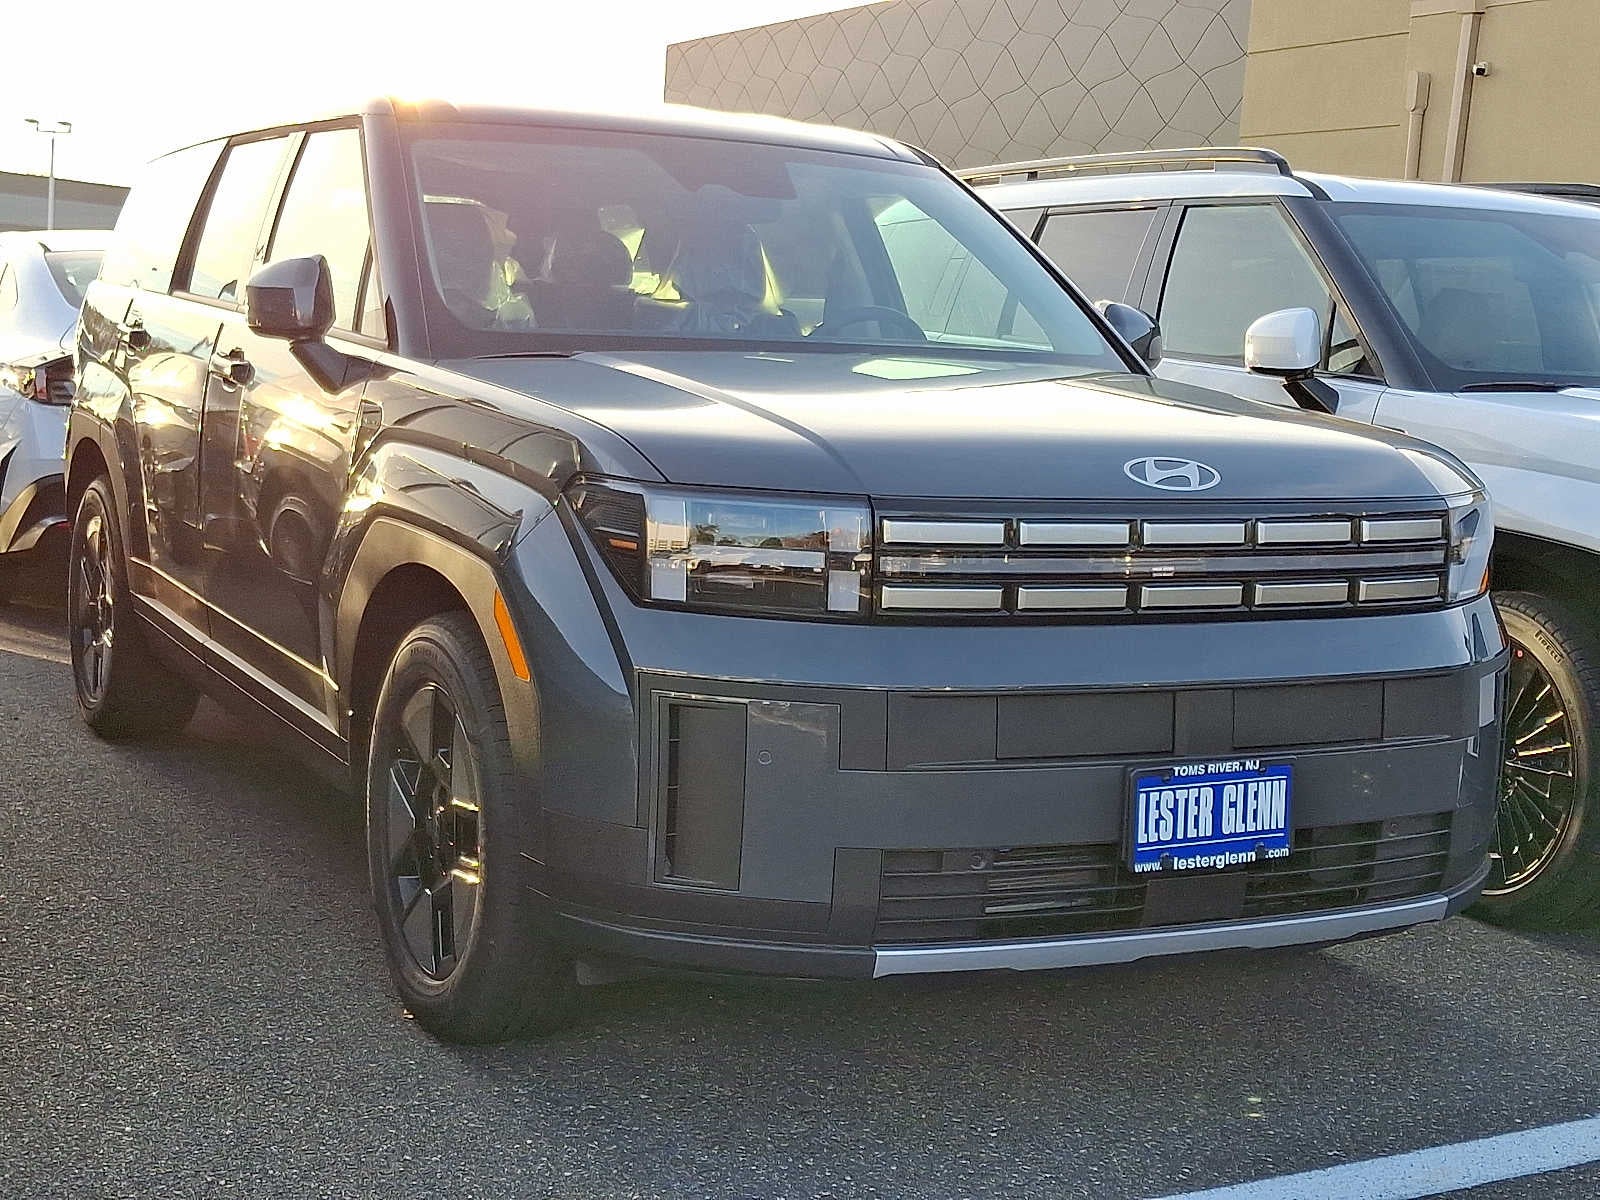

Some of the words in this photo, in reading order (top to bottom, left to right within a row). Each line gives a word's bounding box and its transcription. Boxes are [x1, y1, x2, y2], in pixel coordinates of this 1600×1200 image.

[1173, 765, 1205, 777] TOMS
[1245, 760, 1260, 770] NJ
[1138, 787, 1214, 844] LESTER
[1222, 780, 1287, 835] GLENN
[1134, 861, 1163, 873] www.
[1173, 851, 1256, 870] lesterglenn
[1265, 847, 1290, 859] .com
